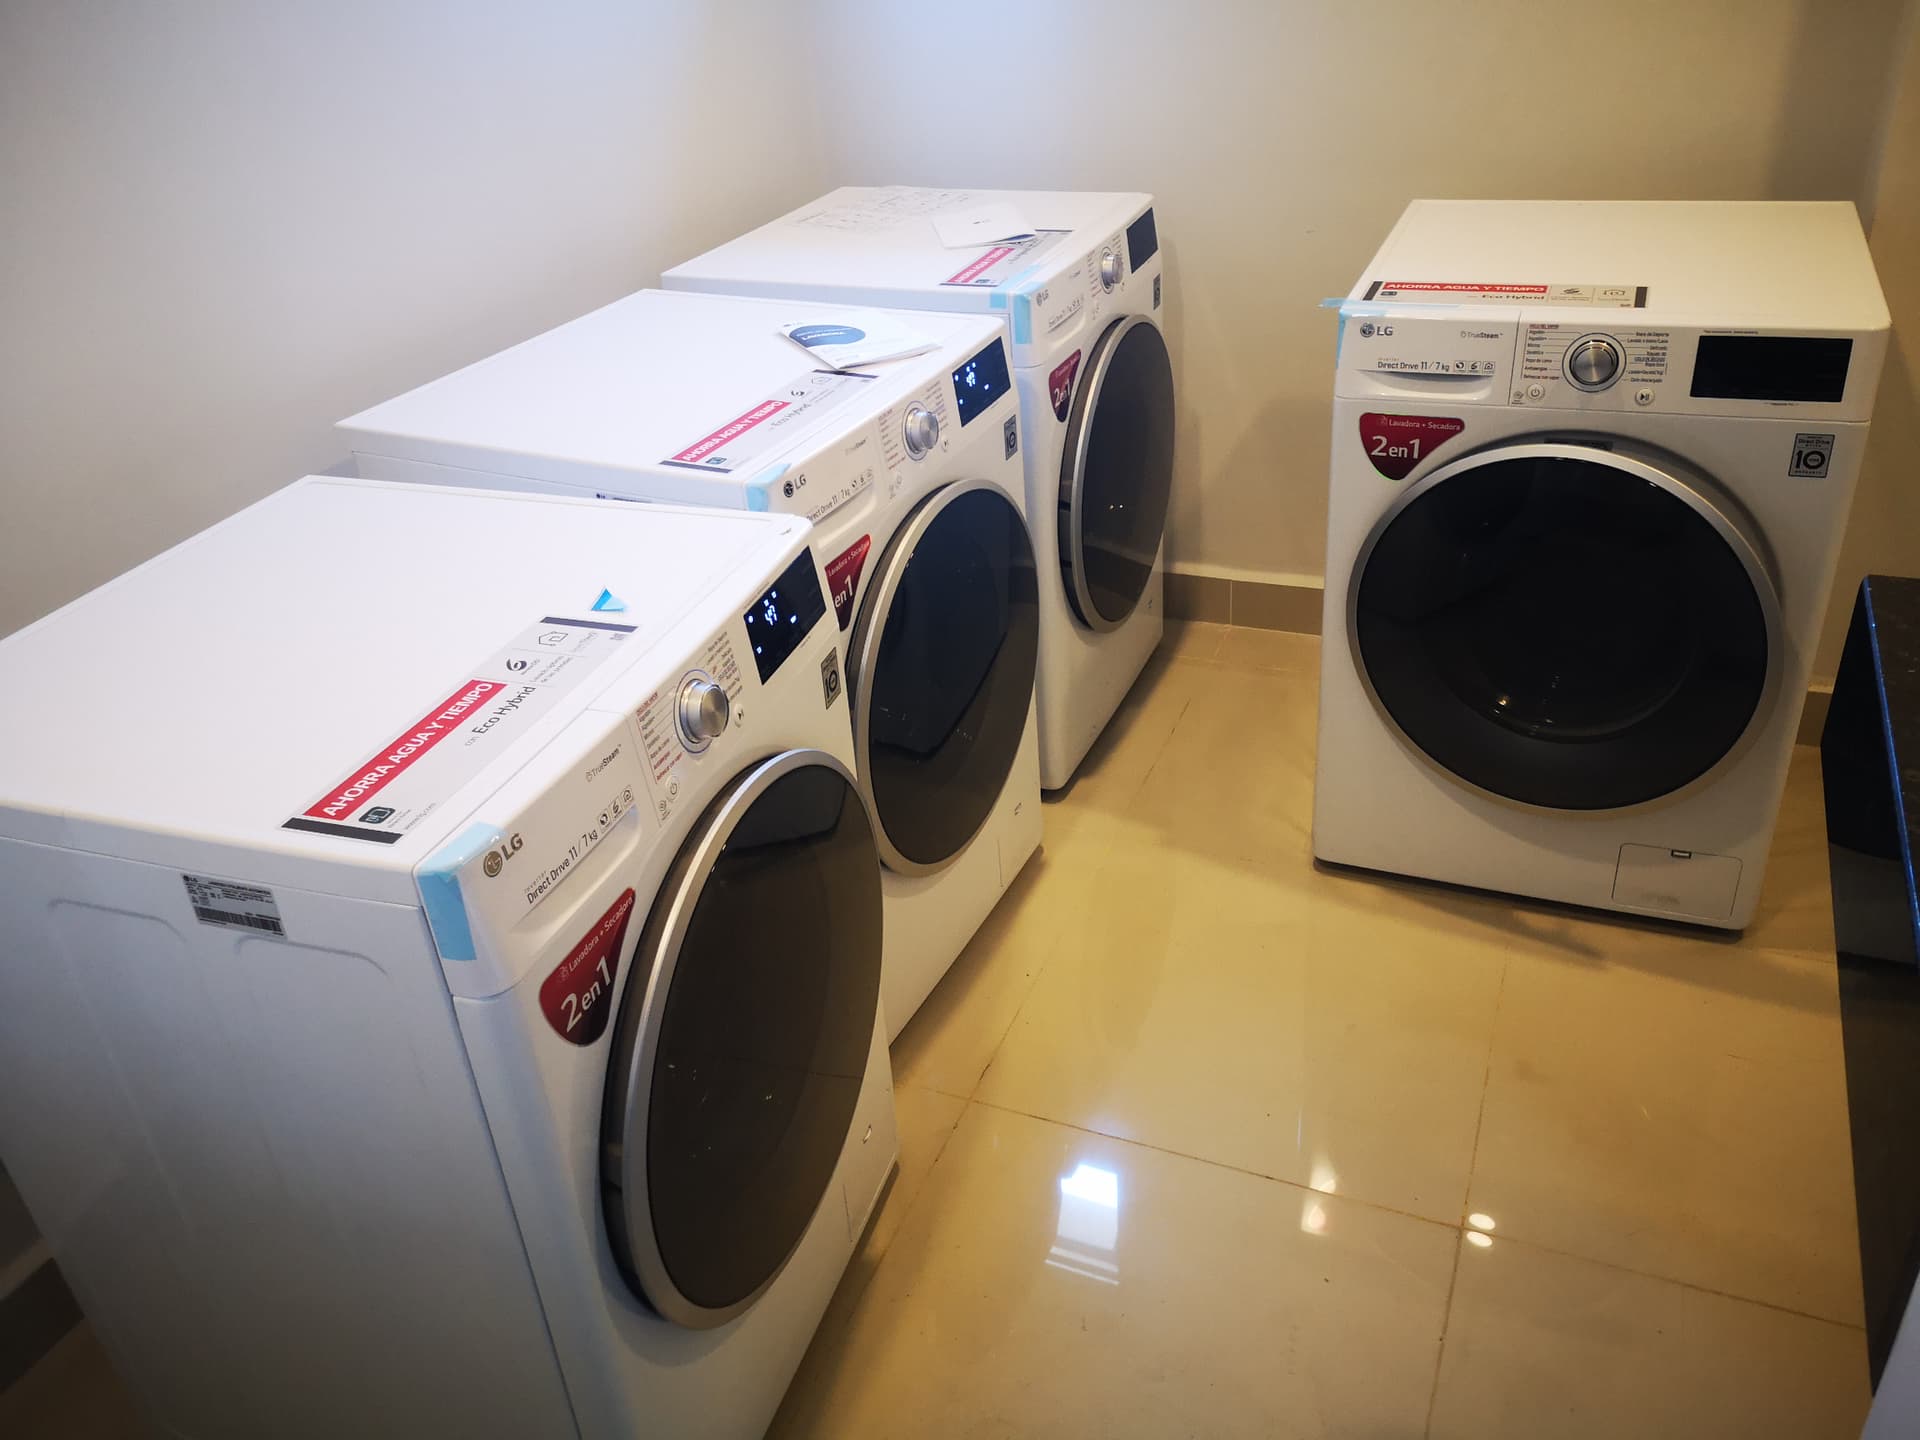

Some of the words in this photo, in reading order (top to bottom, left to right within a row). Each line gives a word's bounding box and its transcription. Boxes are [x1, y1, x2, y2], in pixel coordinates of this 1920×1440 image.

[1386, 282, 1440, 290] AHORRA
[1376, 326, 1393, 336] LG
[1377, 361, 1399, 369] Direct
[1400, 362, 1418, 370] Drive
[682, 438, 724, 462] AHORRA
[718, 421, 745, 440] AGUA
[747, 400, 784, 422] TIEMPO
[1388, 418, 1420, 428] Lavadora
[1427, 421, 1460, 431] Secadora
[1795, 449, 1826, 470] 10
[794, 473, 807, 490] LG
[472, 714, 501, 736] Eco
[494, 686, 537, 716] Hybrid
[322, 764, 396, 817] AHORRA
[388, 730, 437, 764] AGUA
[425, 721, 445, 733] Y
[436, 682, 493, 721] TIEMPO
[501, 832, 524, 861] LG
[527, 876, 552, 905] Direct
[550, 858, 571, 881] Drive
[568, 845, 578, 861] 11
[568, 934, 600, 972] Lavadora
[604, 896, 633, 932] Secadora
